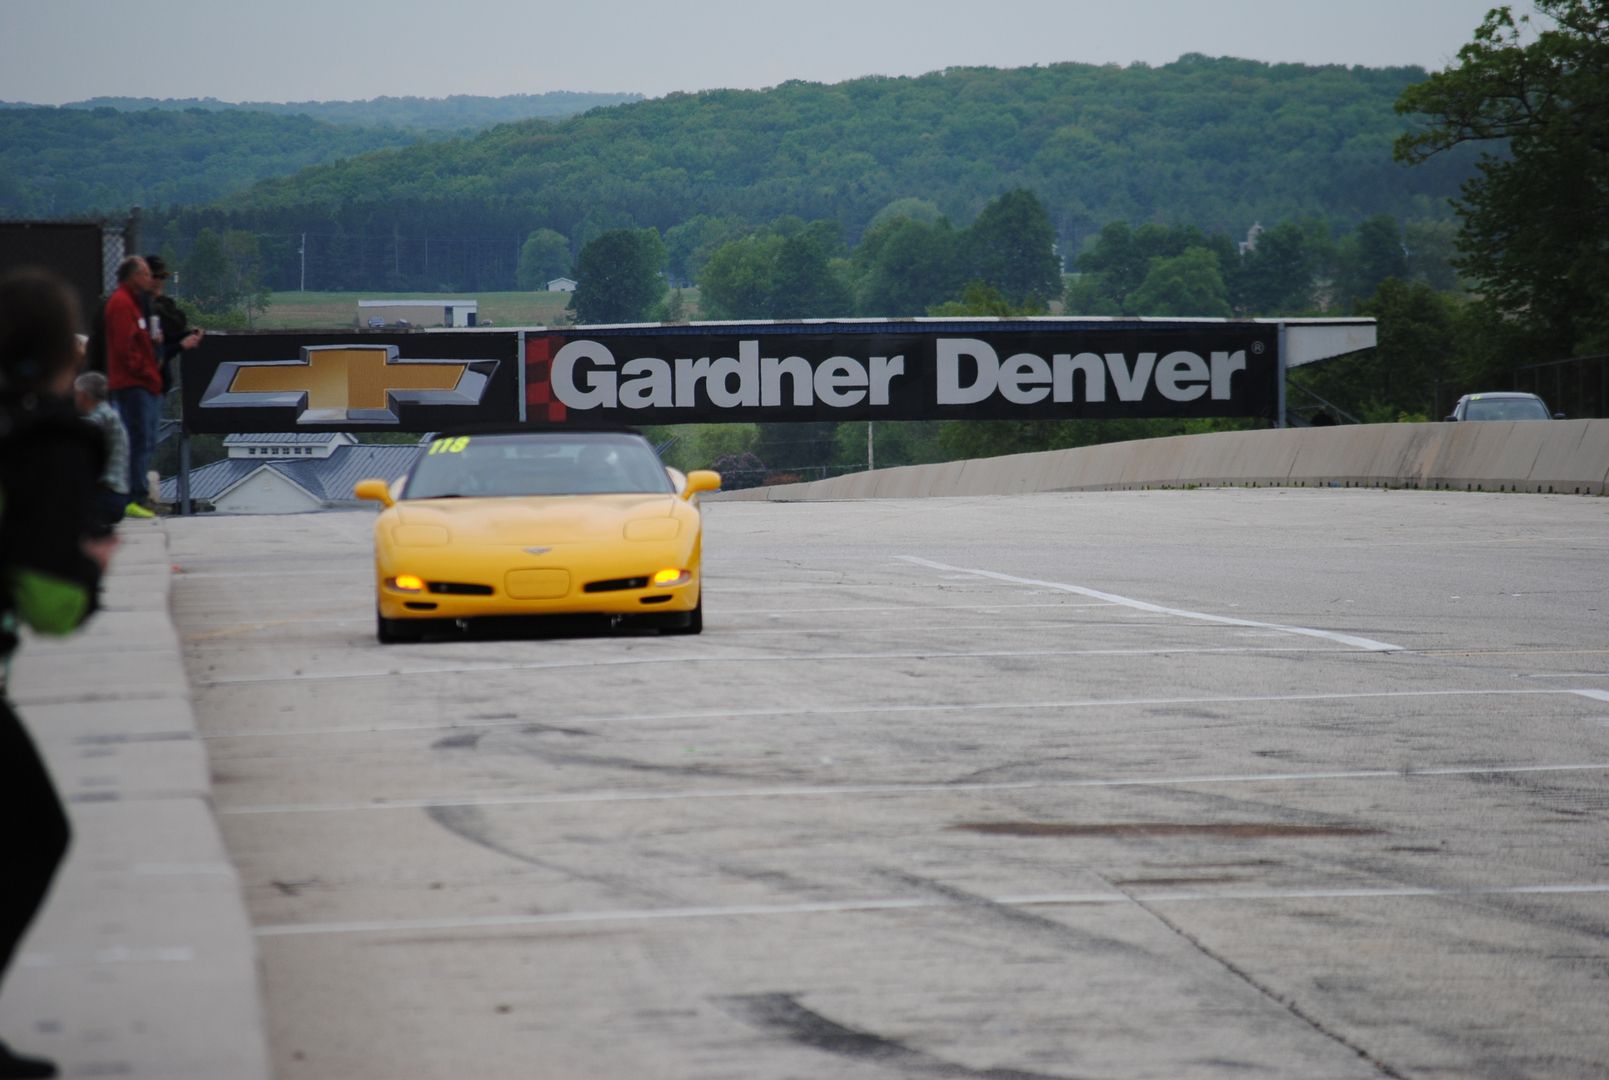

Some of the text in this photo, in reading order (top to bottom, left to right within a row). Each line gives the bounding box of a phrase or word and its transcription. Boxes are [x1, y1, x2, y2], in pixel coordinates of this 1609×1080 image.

[551, 340, 905, 410] Gardner
[936, 338, 1246, 405] Denver
[428, 437, 470, 455] 118
